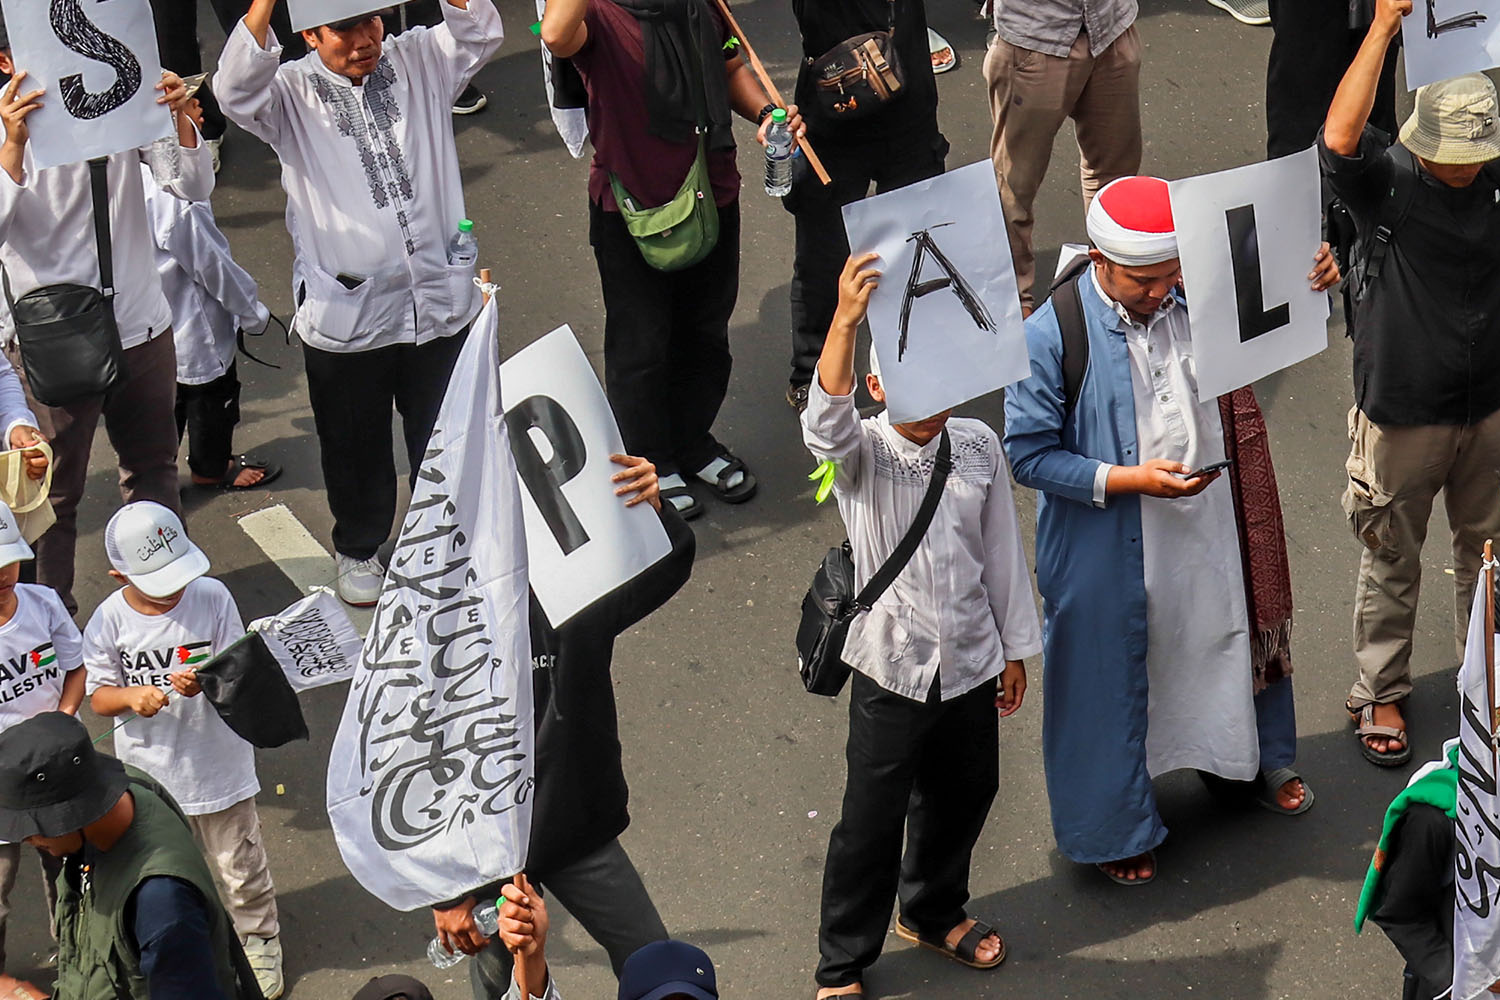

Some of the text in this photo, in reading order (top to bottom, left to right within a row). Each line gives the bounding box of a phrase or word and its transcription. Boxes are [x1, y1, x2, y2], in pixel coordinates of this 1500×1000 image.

[899, 223, 996, 362] A
[1225, 204, 1290, 343] L
[504, 394, 590, 556] P
